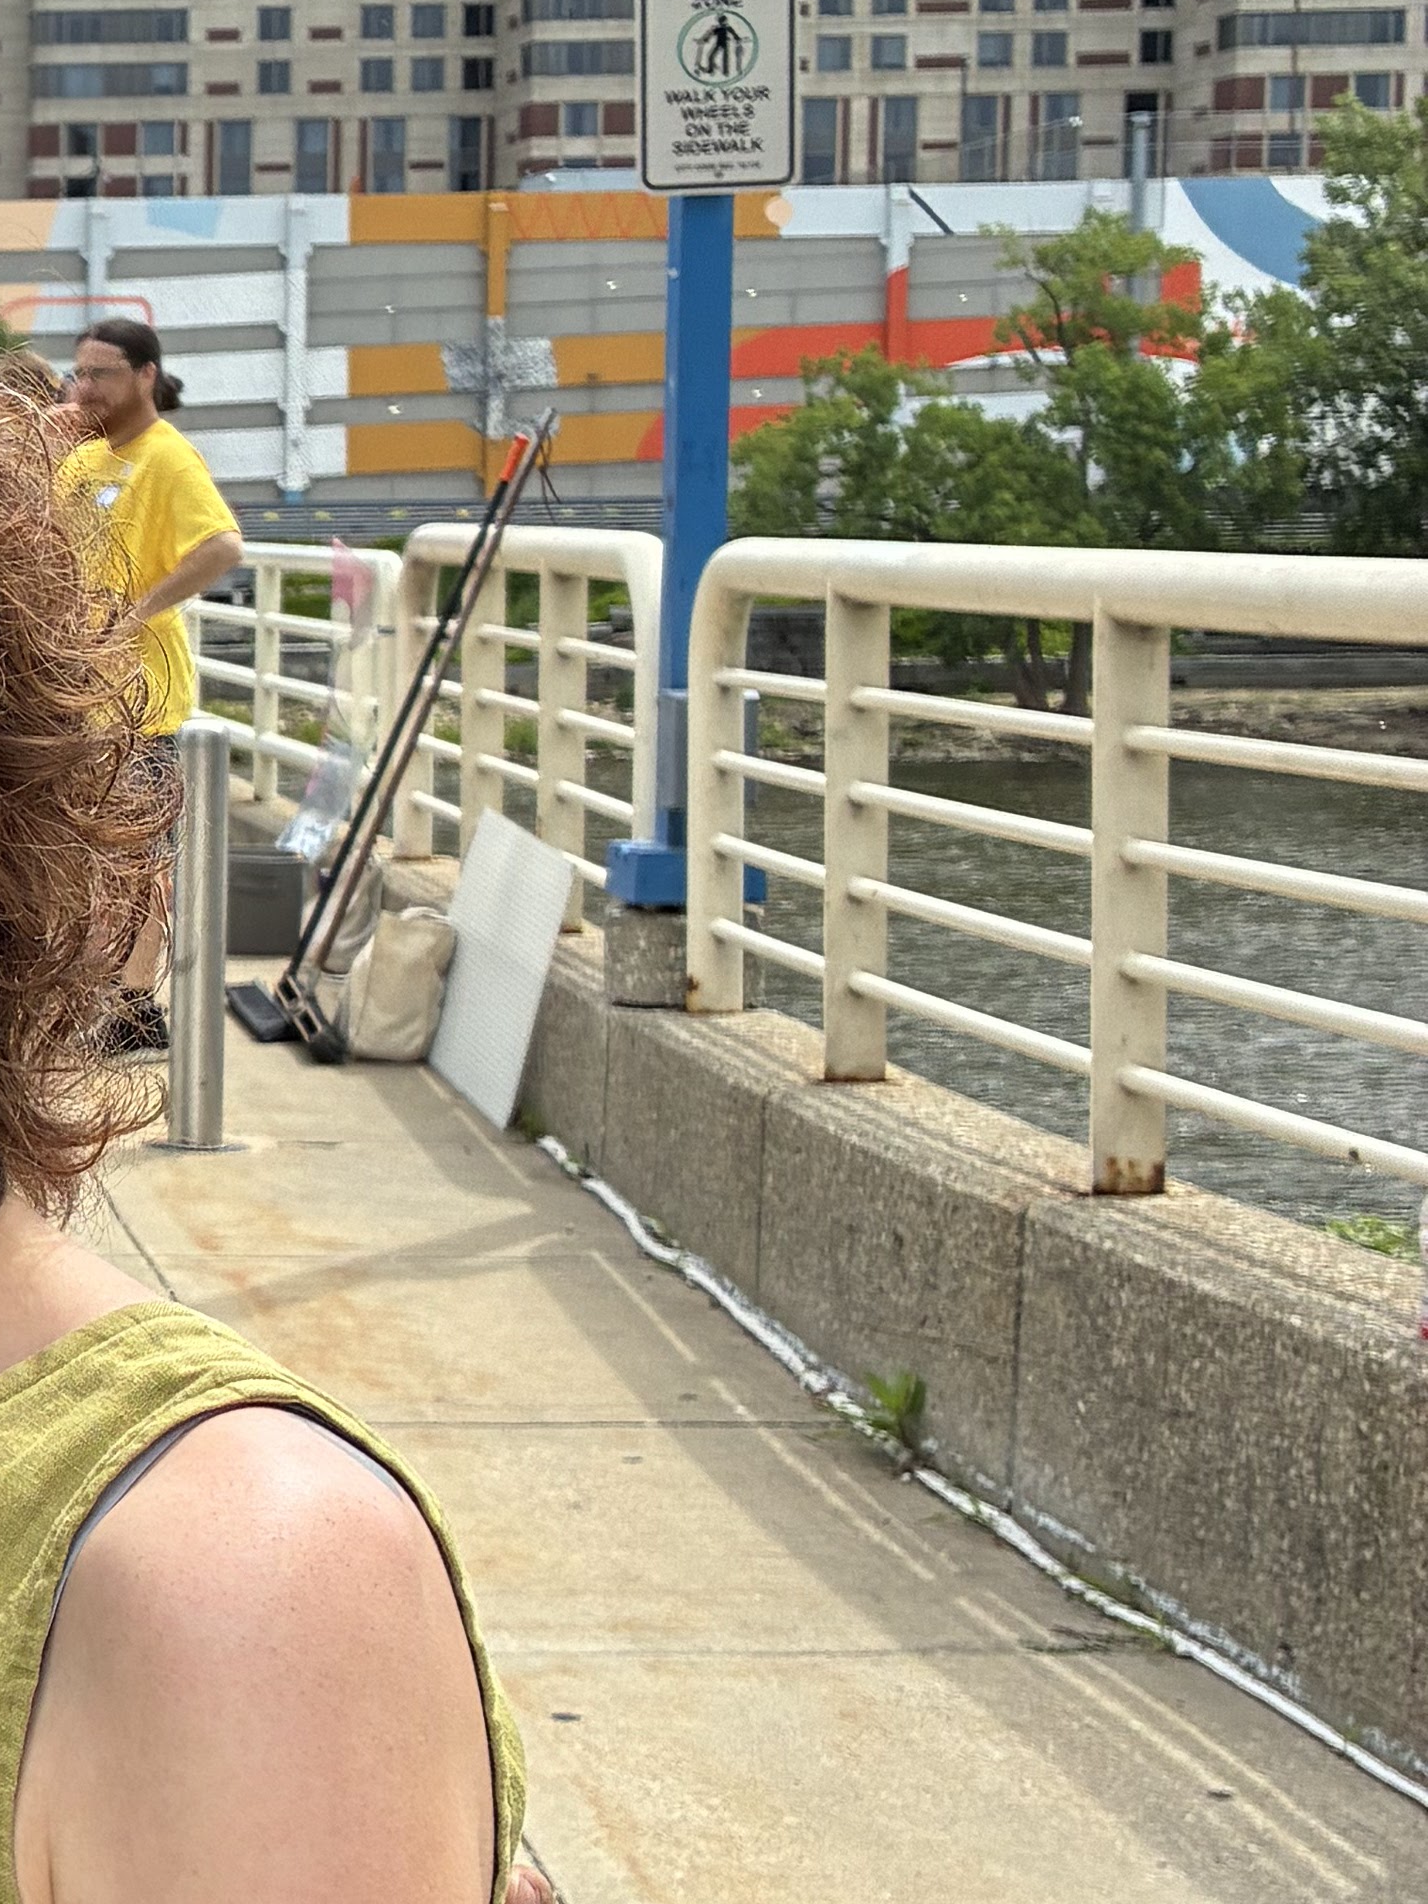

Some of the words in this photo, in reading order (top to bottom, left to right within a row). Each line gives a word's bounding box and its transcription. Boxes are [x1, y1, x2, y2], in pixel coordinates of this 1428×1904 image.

[664, 89, 716, 104] WALK
[720, 85, 771, 102] YOUR
[679, 103, 755, 120] WHEELS
[685, 122, 712, 138] ON
[715, 120, 751, 137] THE
[671, 137, 765, 156] SIDEWALK
